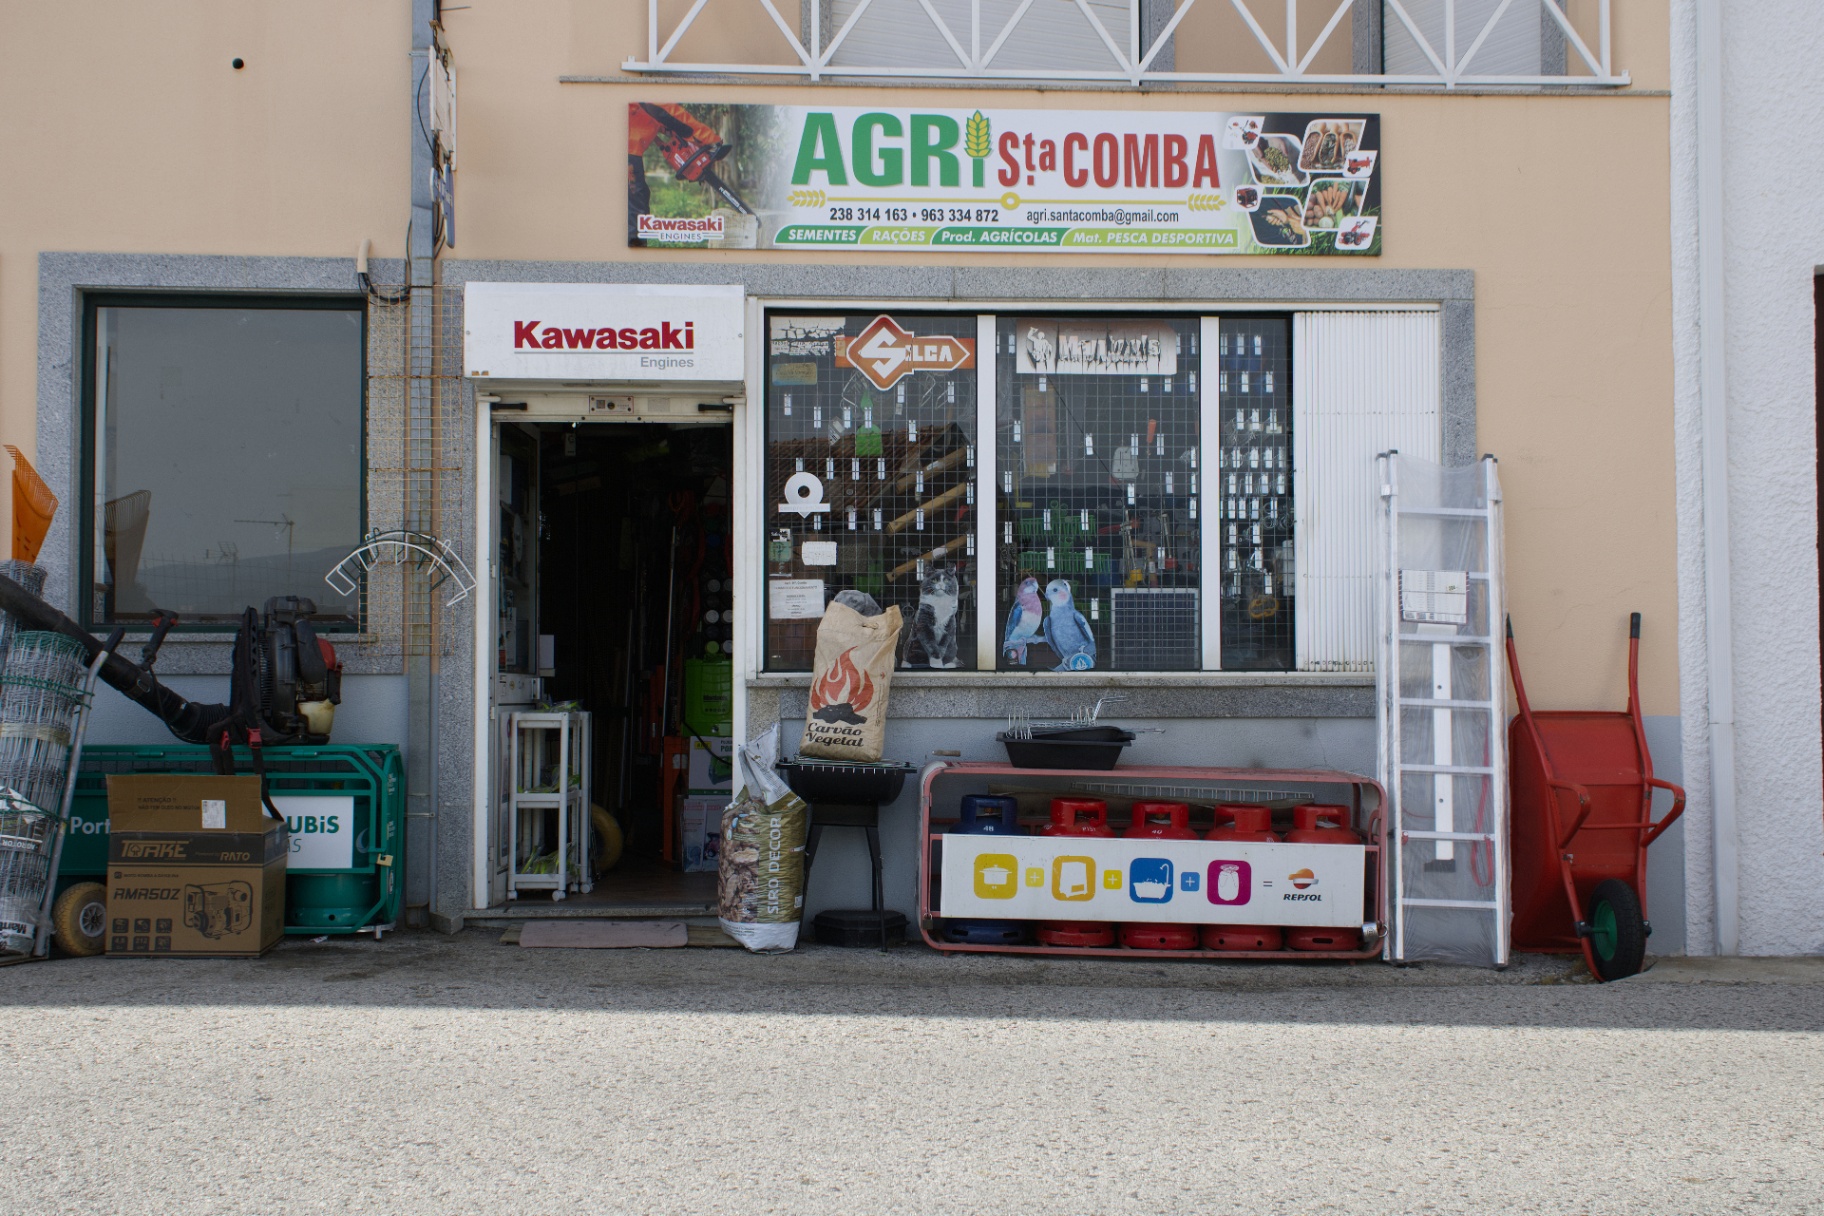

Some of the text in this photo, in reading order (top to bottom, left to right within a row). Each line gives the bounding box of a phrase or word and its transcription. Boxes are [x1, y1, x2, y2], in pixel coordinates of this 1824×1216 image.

[1063, 132, 1221, 188] COMBA
[829, 207, 999, 222] 238 314 163 963 334 872
[1027, 208, 1179, 225] agri.santacomba@gmail.com
[638, 214, 723, 233] Kawasaki
[659, 232, 702, 242] ENGINES
[787, 228, 856, 242] SEMENTES
[872, 226, 925, 245] RAÇÕES
[941, 229, 1057, 243] Prod. AGRÍCOLAS
[1073, 233, 1234, 245] Mat. PESCA DESPORTIVA
[514, 320, 694, 350] Kawasaki
[640, 357, 694, 370] Engines
[807, 723, 863, 736] Carvão
[805, 733, 864, 748] Vegetal
[768, 817, 782, 914] SIRO DECOR
[1283, 893, 1322, 902] REPSOL
